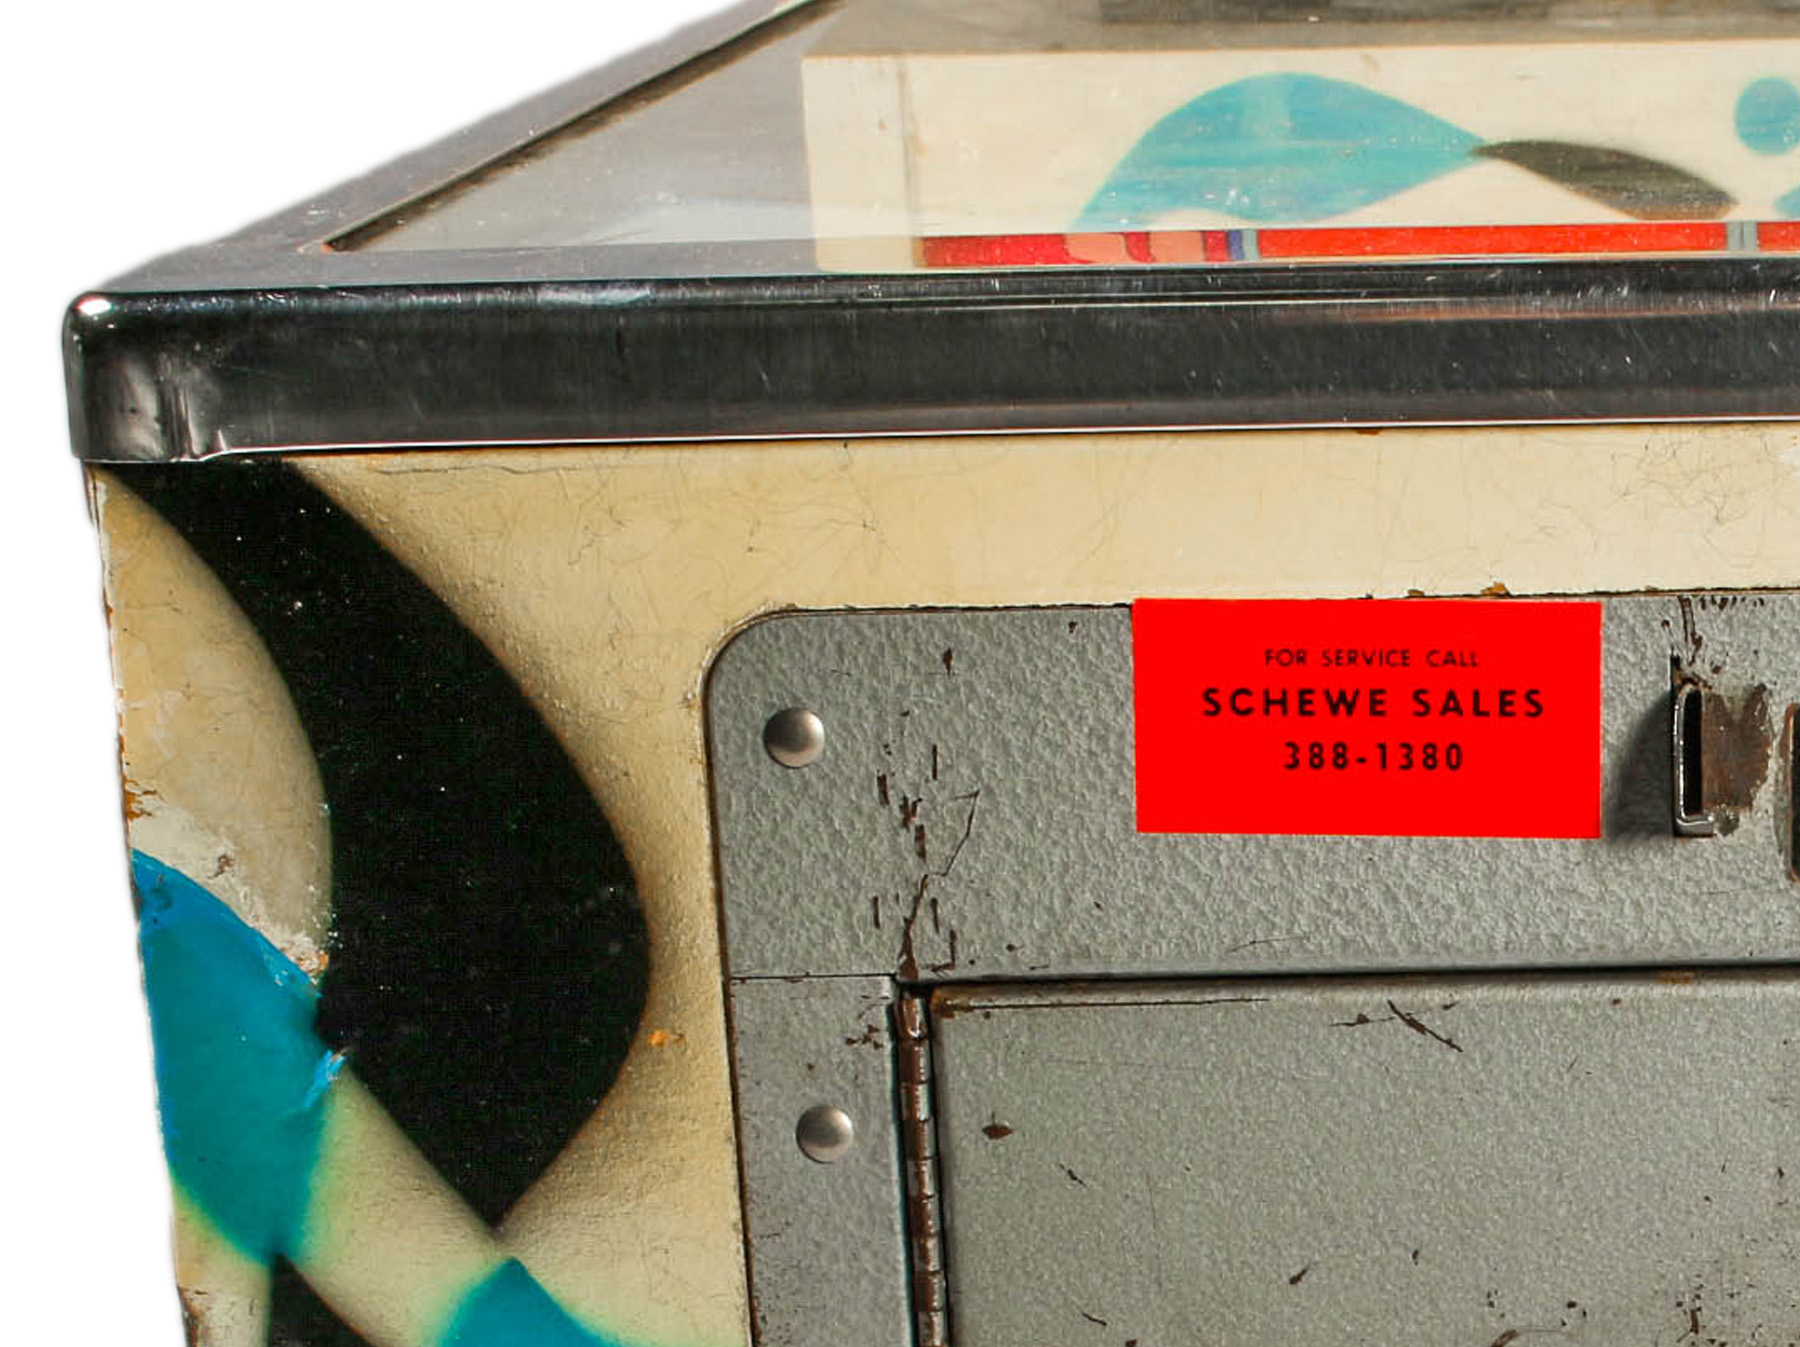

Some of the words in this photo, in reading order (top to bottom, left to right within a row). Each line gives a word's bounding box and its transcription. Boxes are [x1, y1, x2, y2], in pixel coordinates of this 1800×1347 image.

[1265, 649, 1306, 667] FOR
[1322, 649, 1409, 667] SERVICE
[1426, 650, 1477, 667] CALL
[1202, 688, 1386, 717] SCHEWE
[1412, 688, 1543, 718] SALES
[1284, 741, 1463, 771] 388-1380
